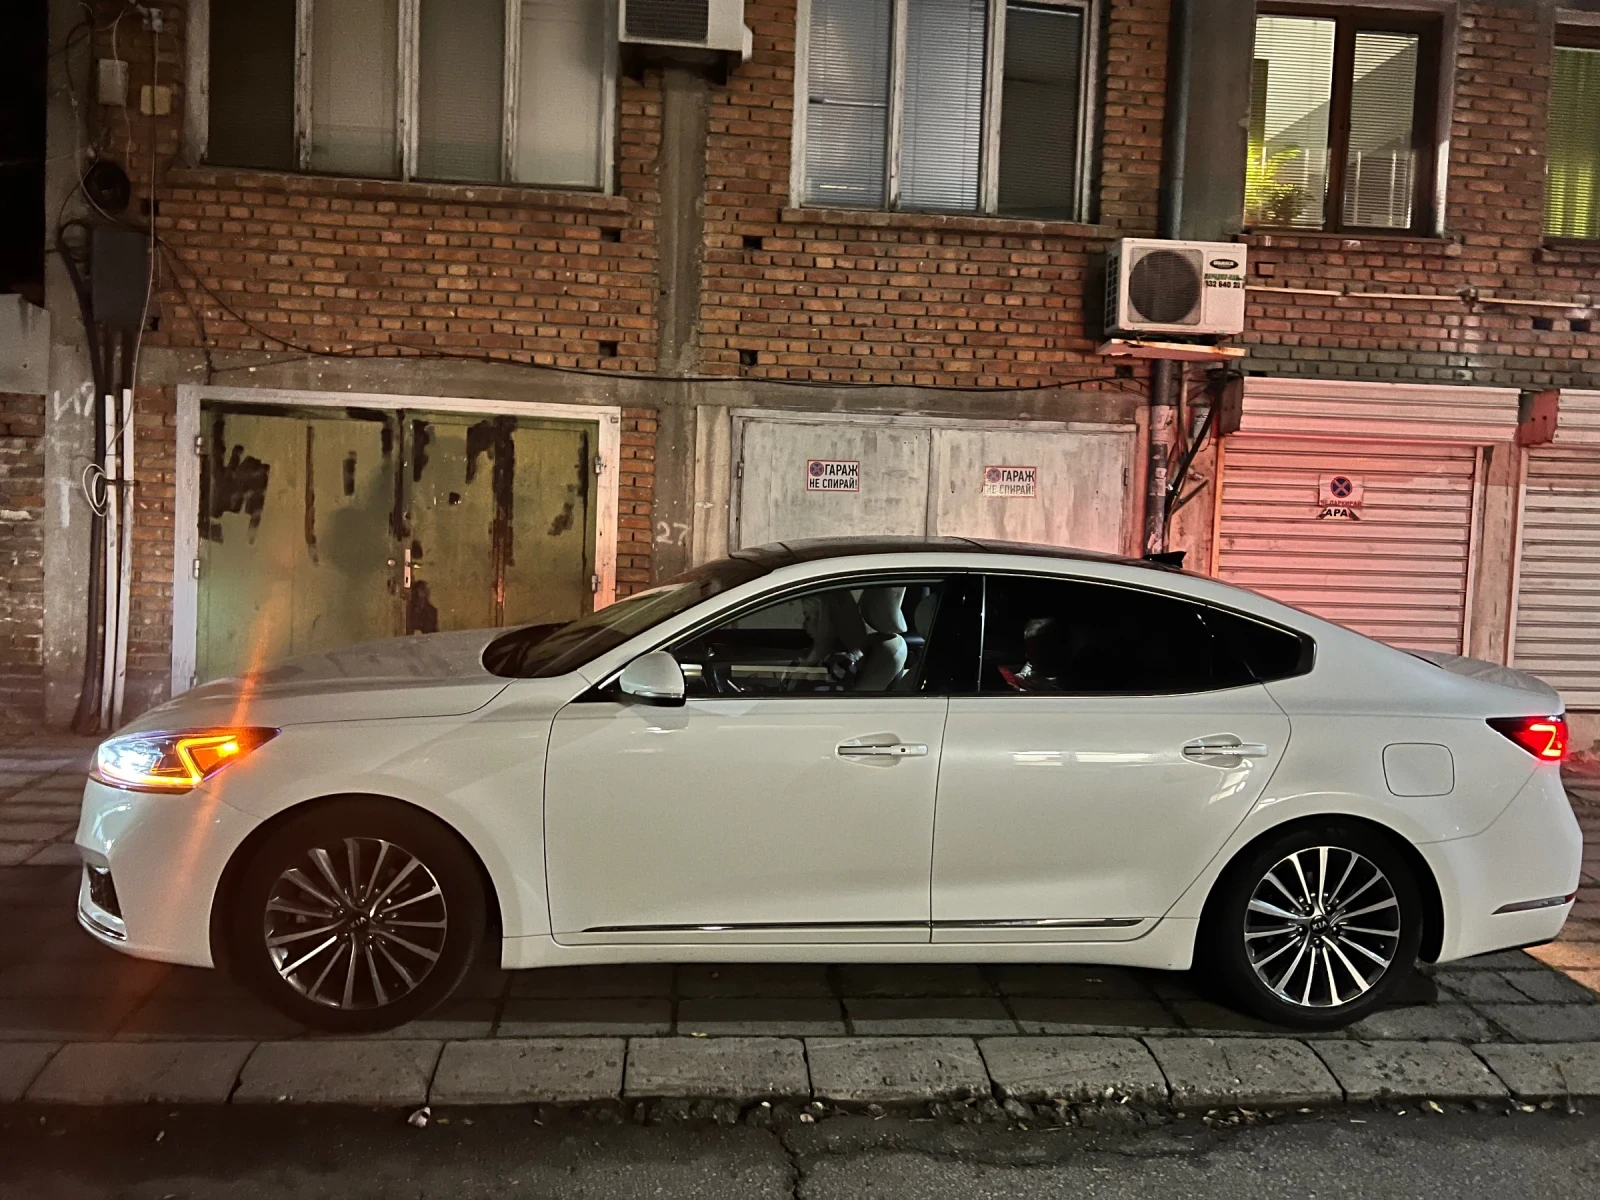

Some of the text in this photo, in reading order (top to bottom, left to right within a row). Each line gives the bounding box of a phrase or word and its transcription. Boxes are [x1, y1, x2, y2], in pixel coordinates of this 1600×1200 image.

[825, 464, 858, 476] ГАРАЖ
[1001, 470, 1035, 482] ГАРАЖ
[810, 477, 858, 489] НЕ СПИРАЙ!
[656, 521, 690, 546] 27
[1312, 920, 1328, 931] KIA
